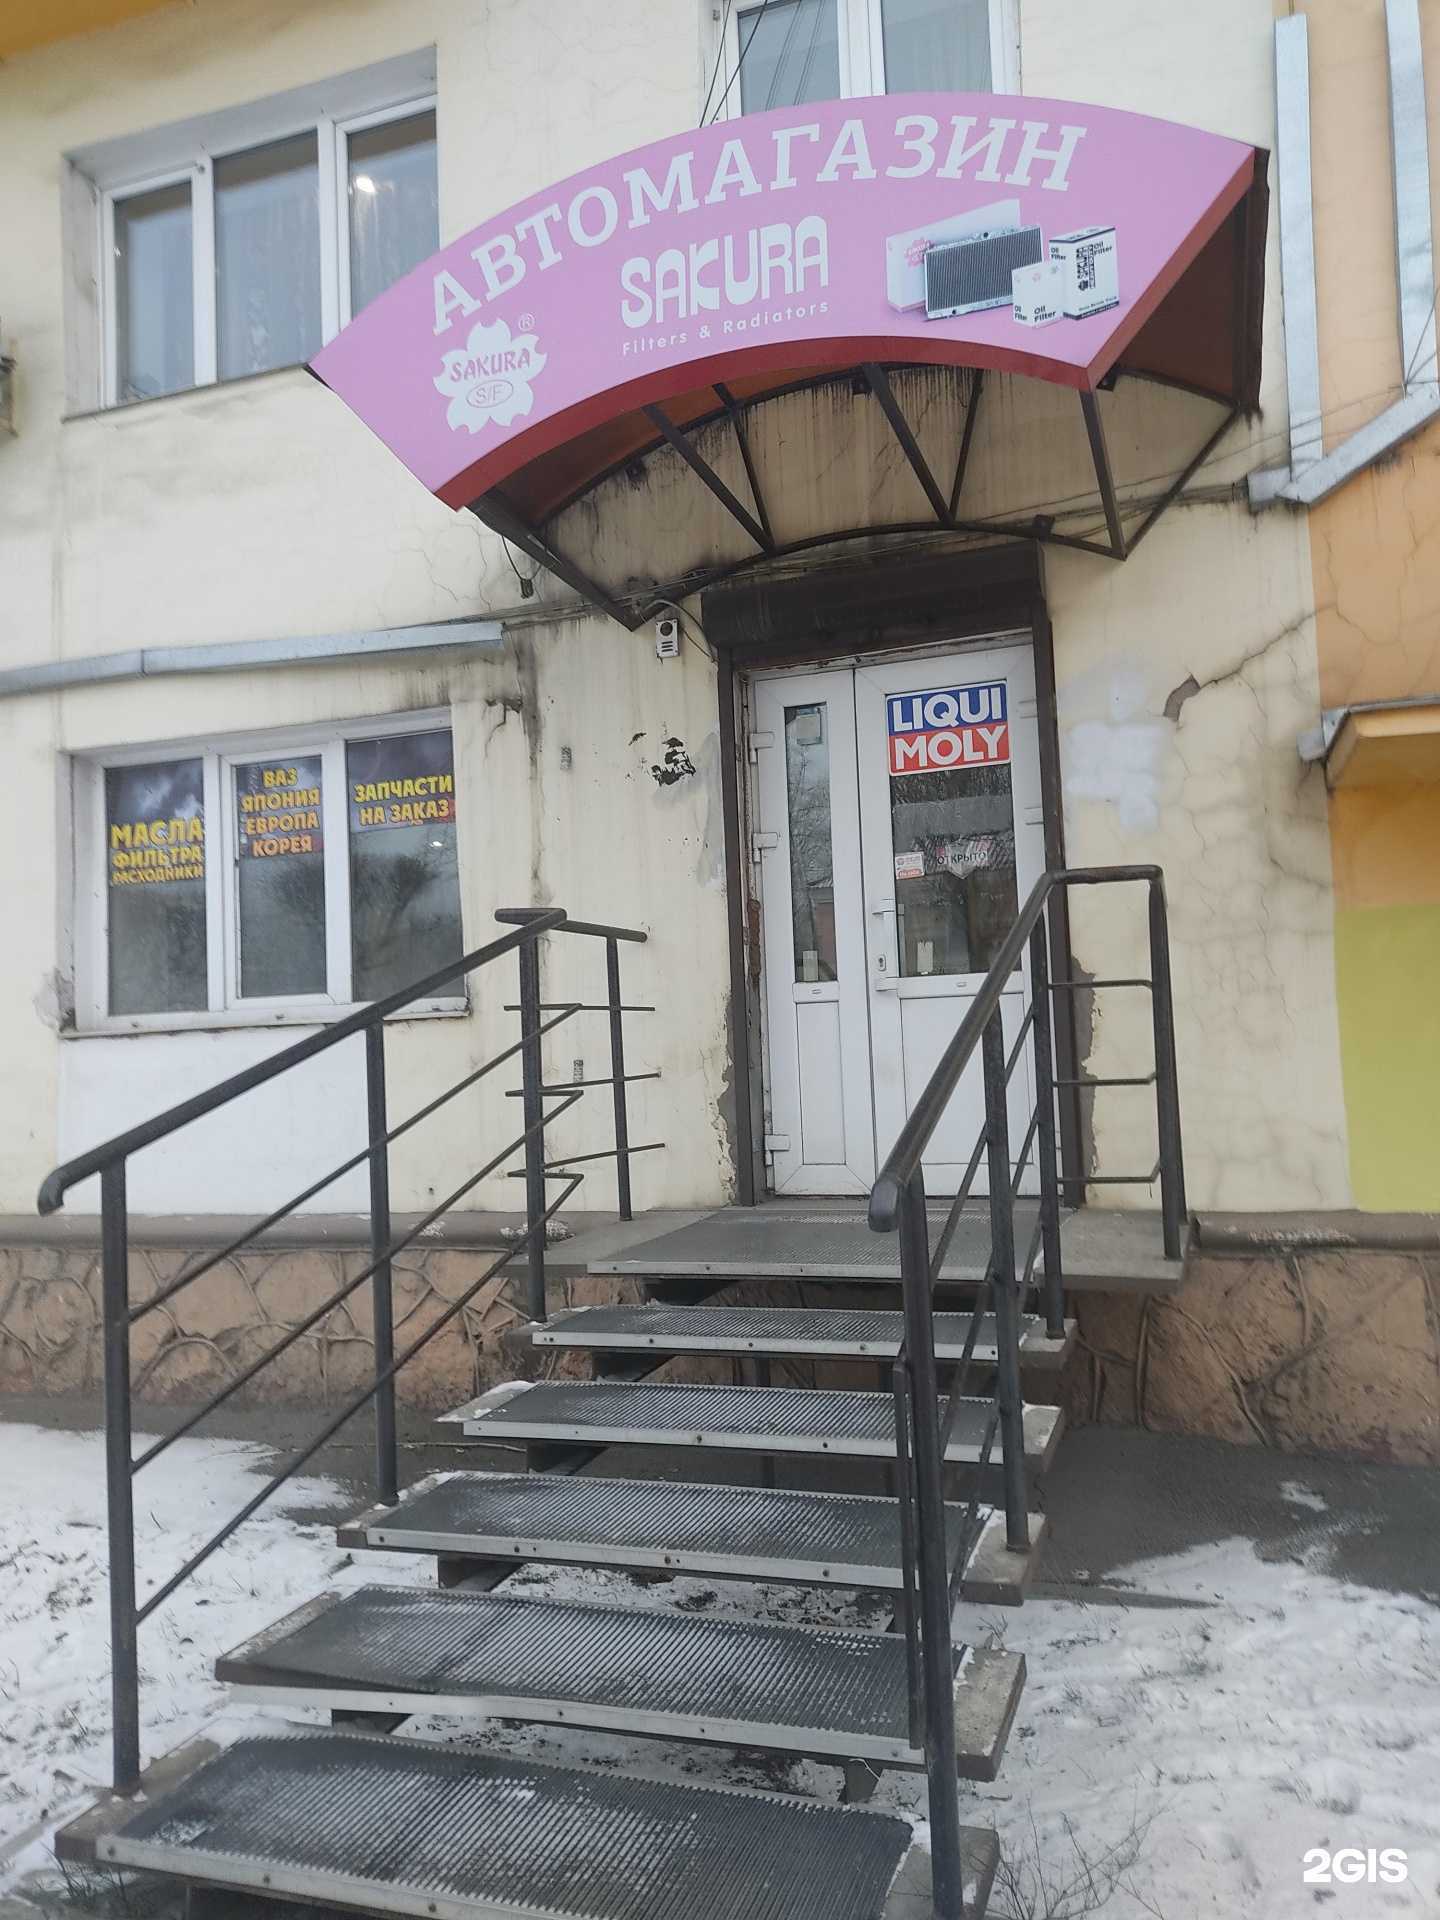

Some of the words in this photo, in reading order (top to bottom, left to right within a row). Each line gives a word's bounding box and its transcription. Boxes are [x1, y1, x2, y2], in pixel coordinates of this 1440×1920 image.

[433, 115, 1087, 336] АВТОМАГАЗИН
[621, 215, 829, 328] SAKURA
[623, 332, 688, 356] Filters
[699, 325, 711, 339] &
[723, 302, 829, 334] Radiators
[450, 347, 531, 383] SAKURA
[892, 686, 1003, 732] LIQUI
[894, 725, 1006, 769] MOLY
[262, 767, 298, 788] ВАЗ
[354, 775, 453, 803] ЗАПЧАСТИ
[240, 788, 320, 812] ЯПОНИЯ
[360, 806, 385, 826] НА
[390, 799, 449, 823] ЗАКАЗ
[111, 816, 204, 848] МАСЛА
[246, 810, 319, 835] ЕВРОПА
[252, 834, 313, 858] КОРЕЯ
[937, 852, 986, 865] ОТКРЫТО
